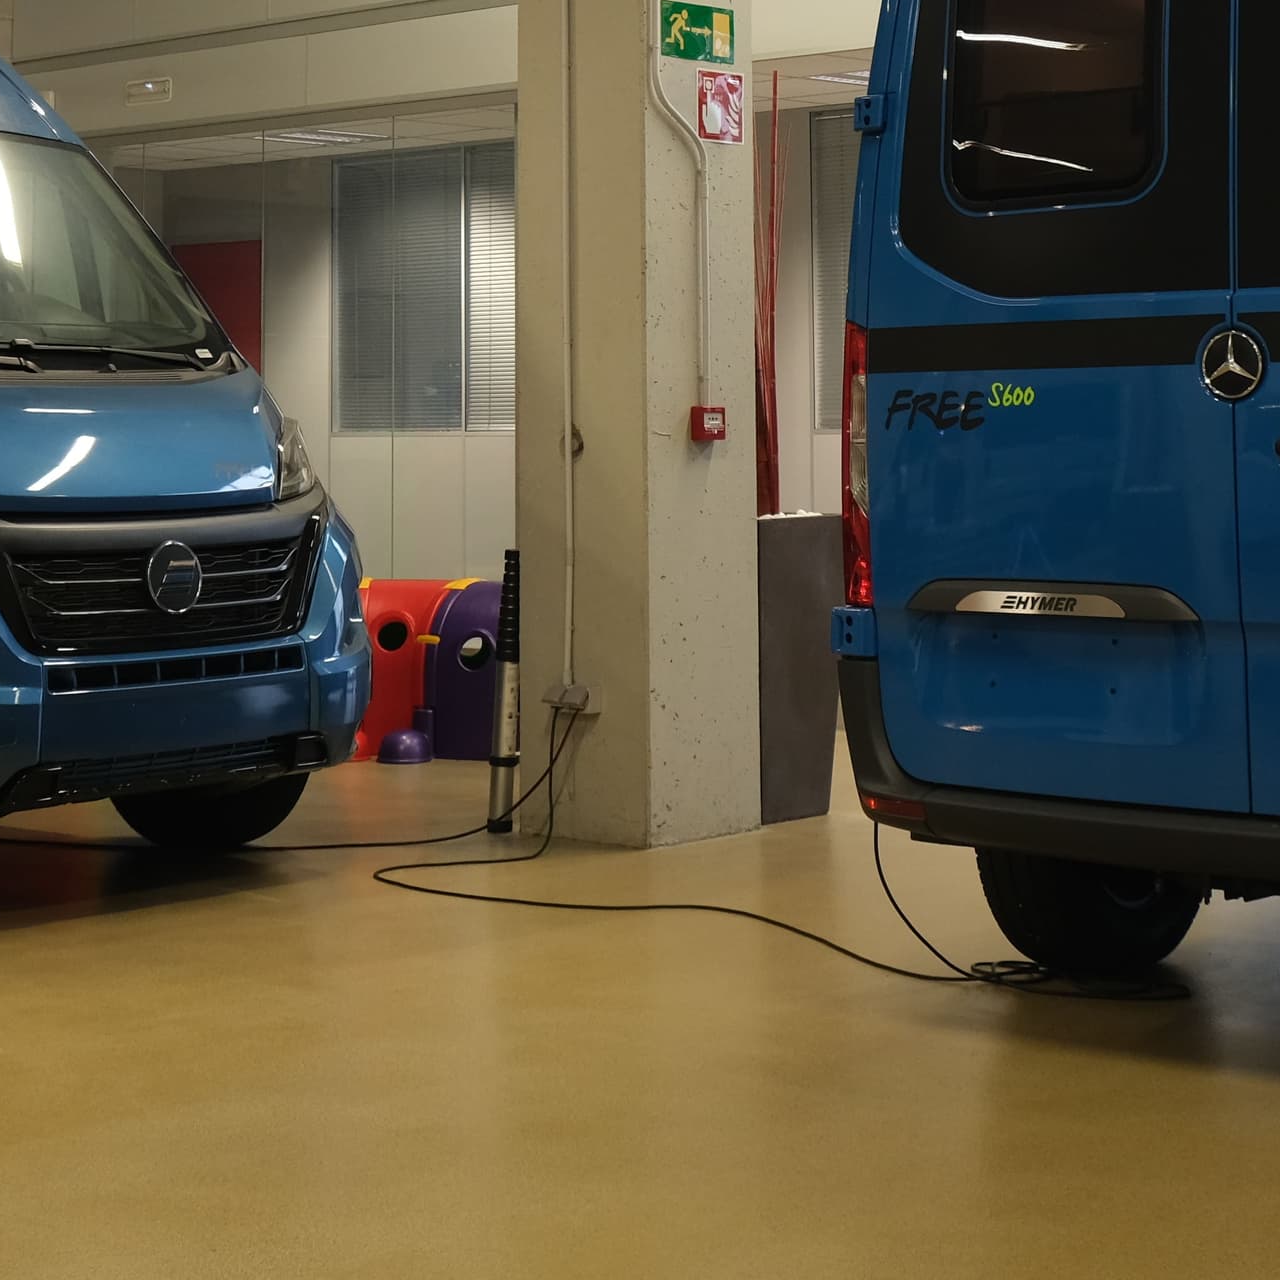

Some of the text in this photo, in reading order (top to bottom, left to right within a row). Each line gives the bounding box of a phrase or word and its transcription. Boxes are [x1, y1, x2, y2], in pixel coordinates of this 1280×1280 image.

[884, 381, 1036, 432] FREE S600
[1015, 595, 1078, 612] HYMER
